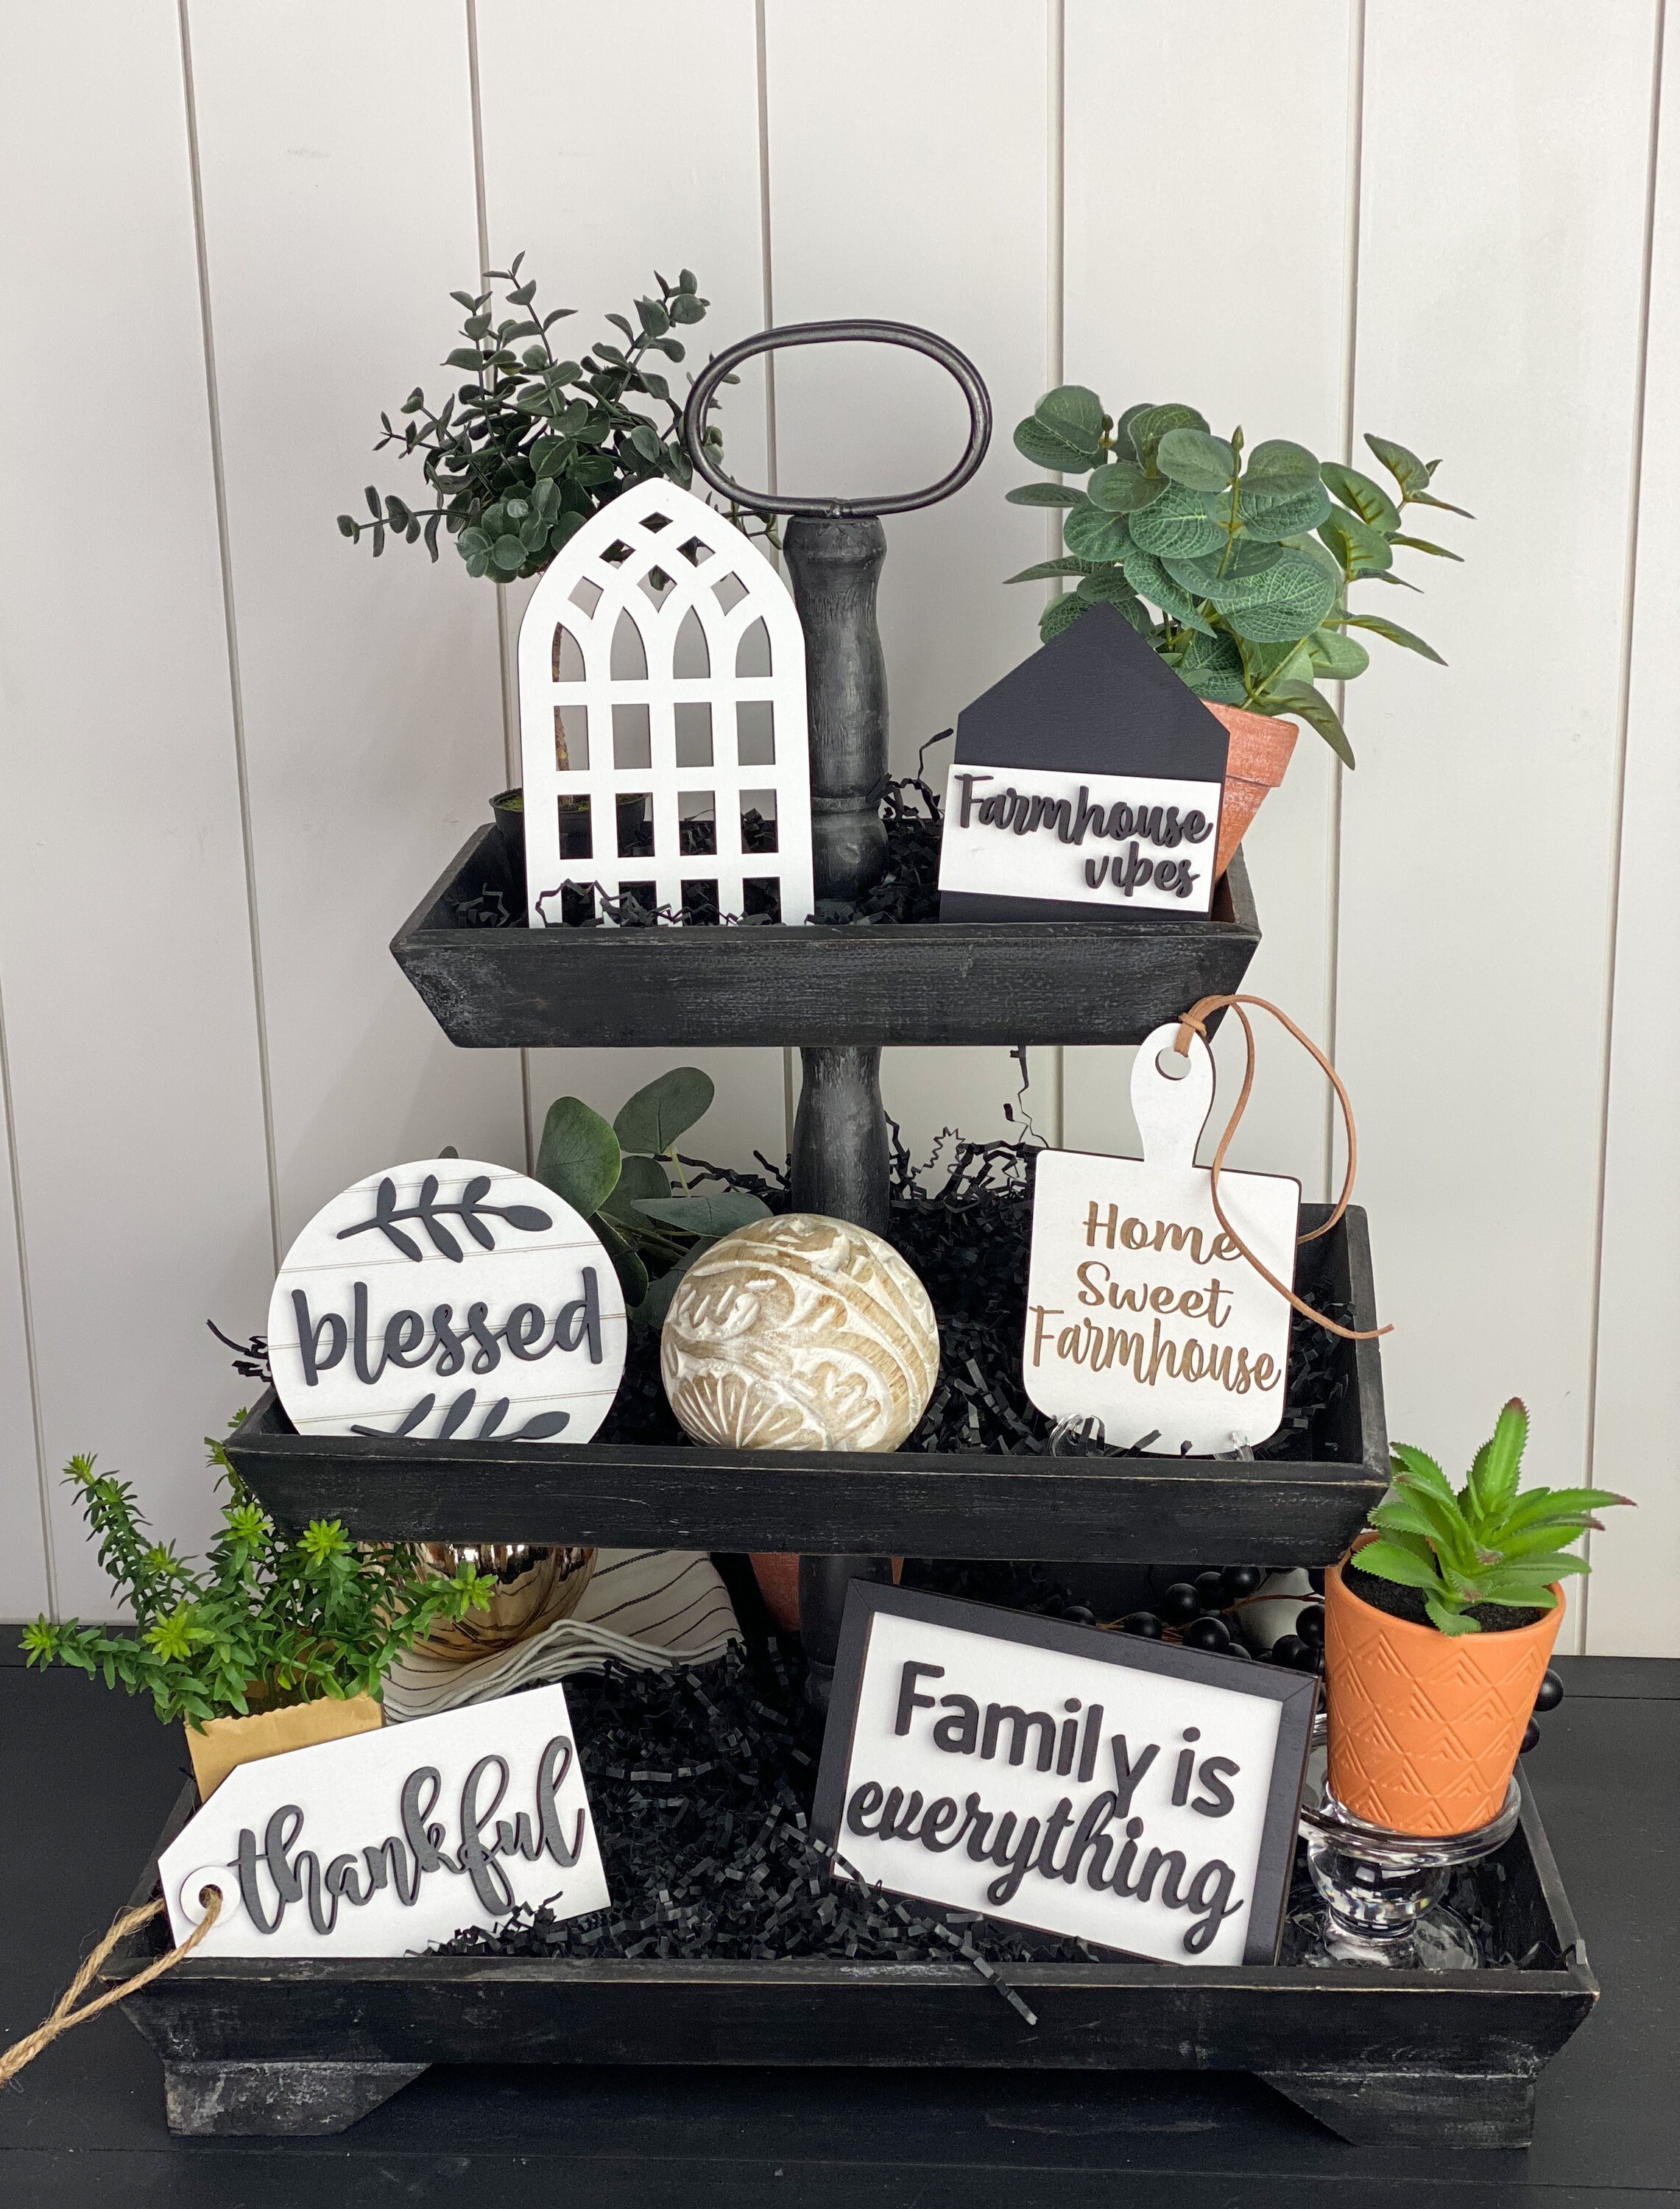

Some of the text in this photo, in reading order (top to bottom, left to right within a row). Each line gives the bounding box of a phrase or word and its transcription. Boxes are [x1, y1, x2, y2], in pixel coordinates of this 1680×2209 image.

[955, 774, 1213, 848] Farmhouse
[1084, 841, 1200, 898] vibes
[1082, 1200, 1244, 1265] Home
[291, 1266, 603, 1387] blessed
[1076, 1261, 1234, 1328] Sweet
[1028, 1305, 1282, 1395] Farmhouse
[894, 1660, 1240, 1819] Family is
[227, 1735, 585, 1934] thankful
[846, 1780, 1244, 1955] everything
